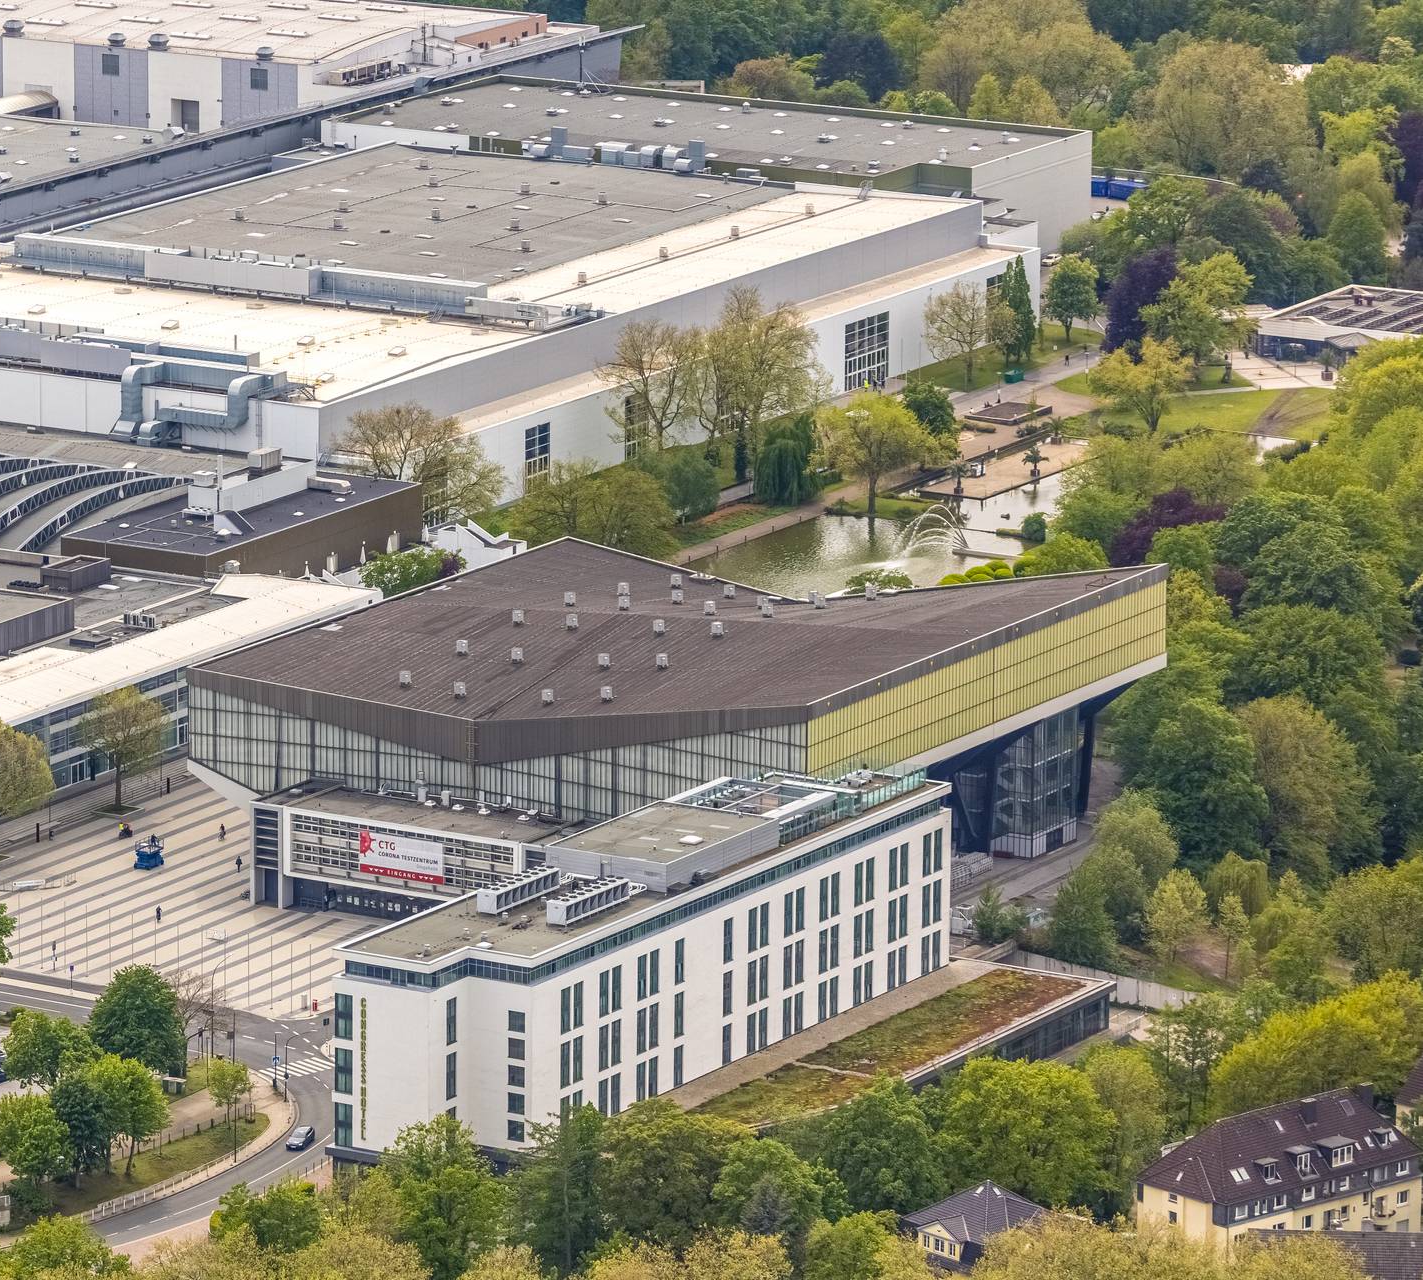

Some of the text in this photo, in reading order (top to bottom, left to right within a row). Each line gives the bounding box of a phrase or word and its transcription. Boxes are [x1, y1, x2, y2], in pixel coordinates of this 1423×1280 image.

[378, 840, 396, 851] CTG
[378, 851, 439, 865] CORONA TESTZENTRUM
[387, 869, 416, 879] EINGANG
